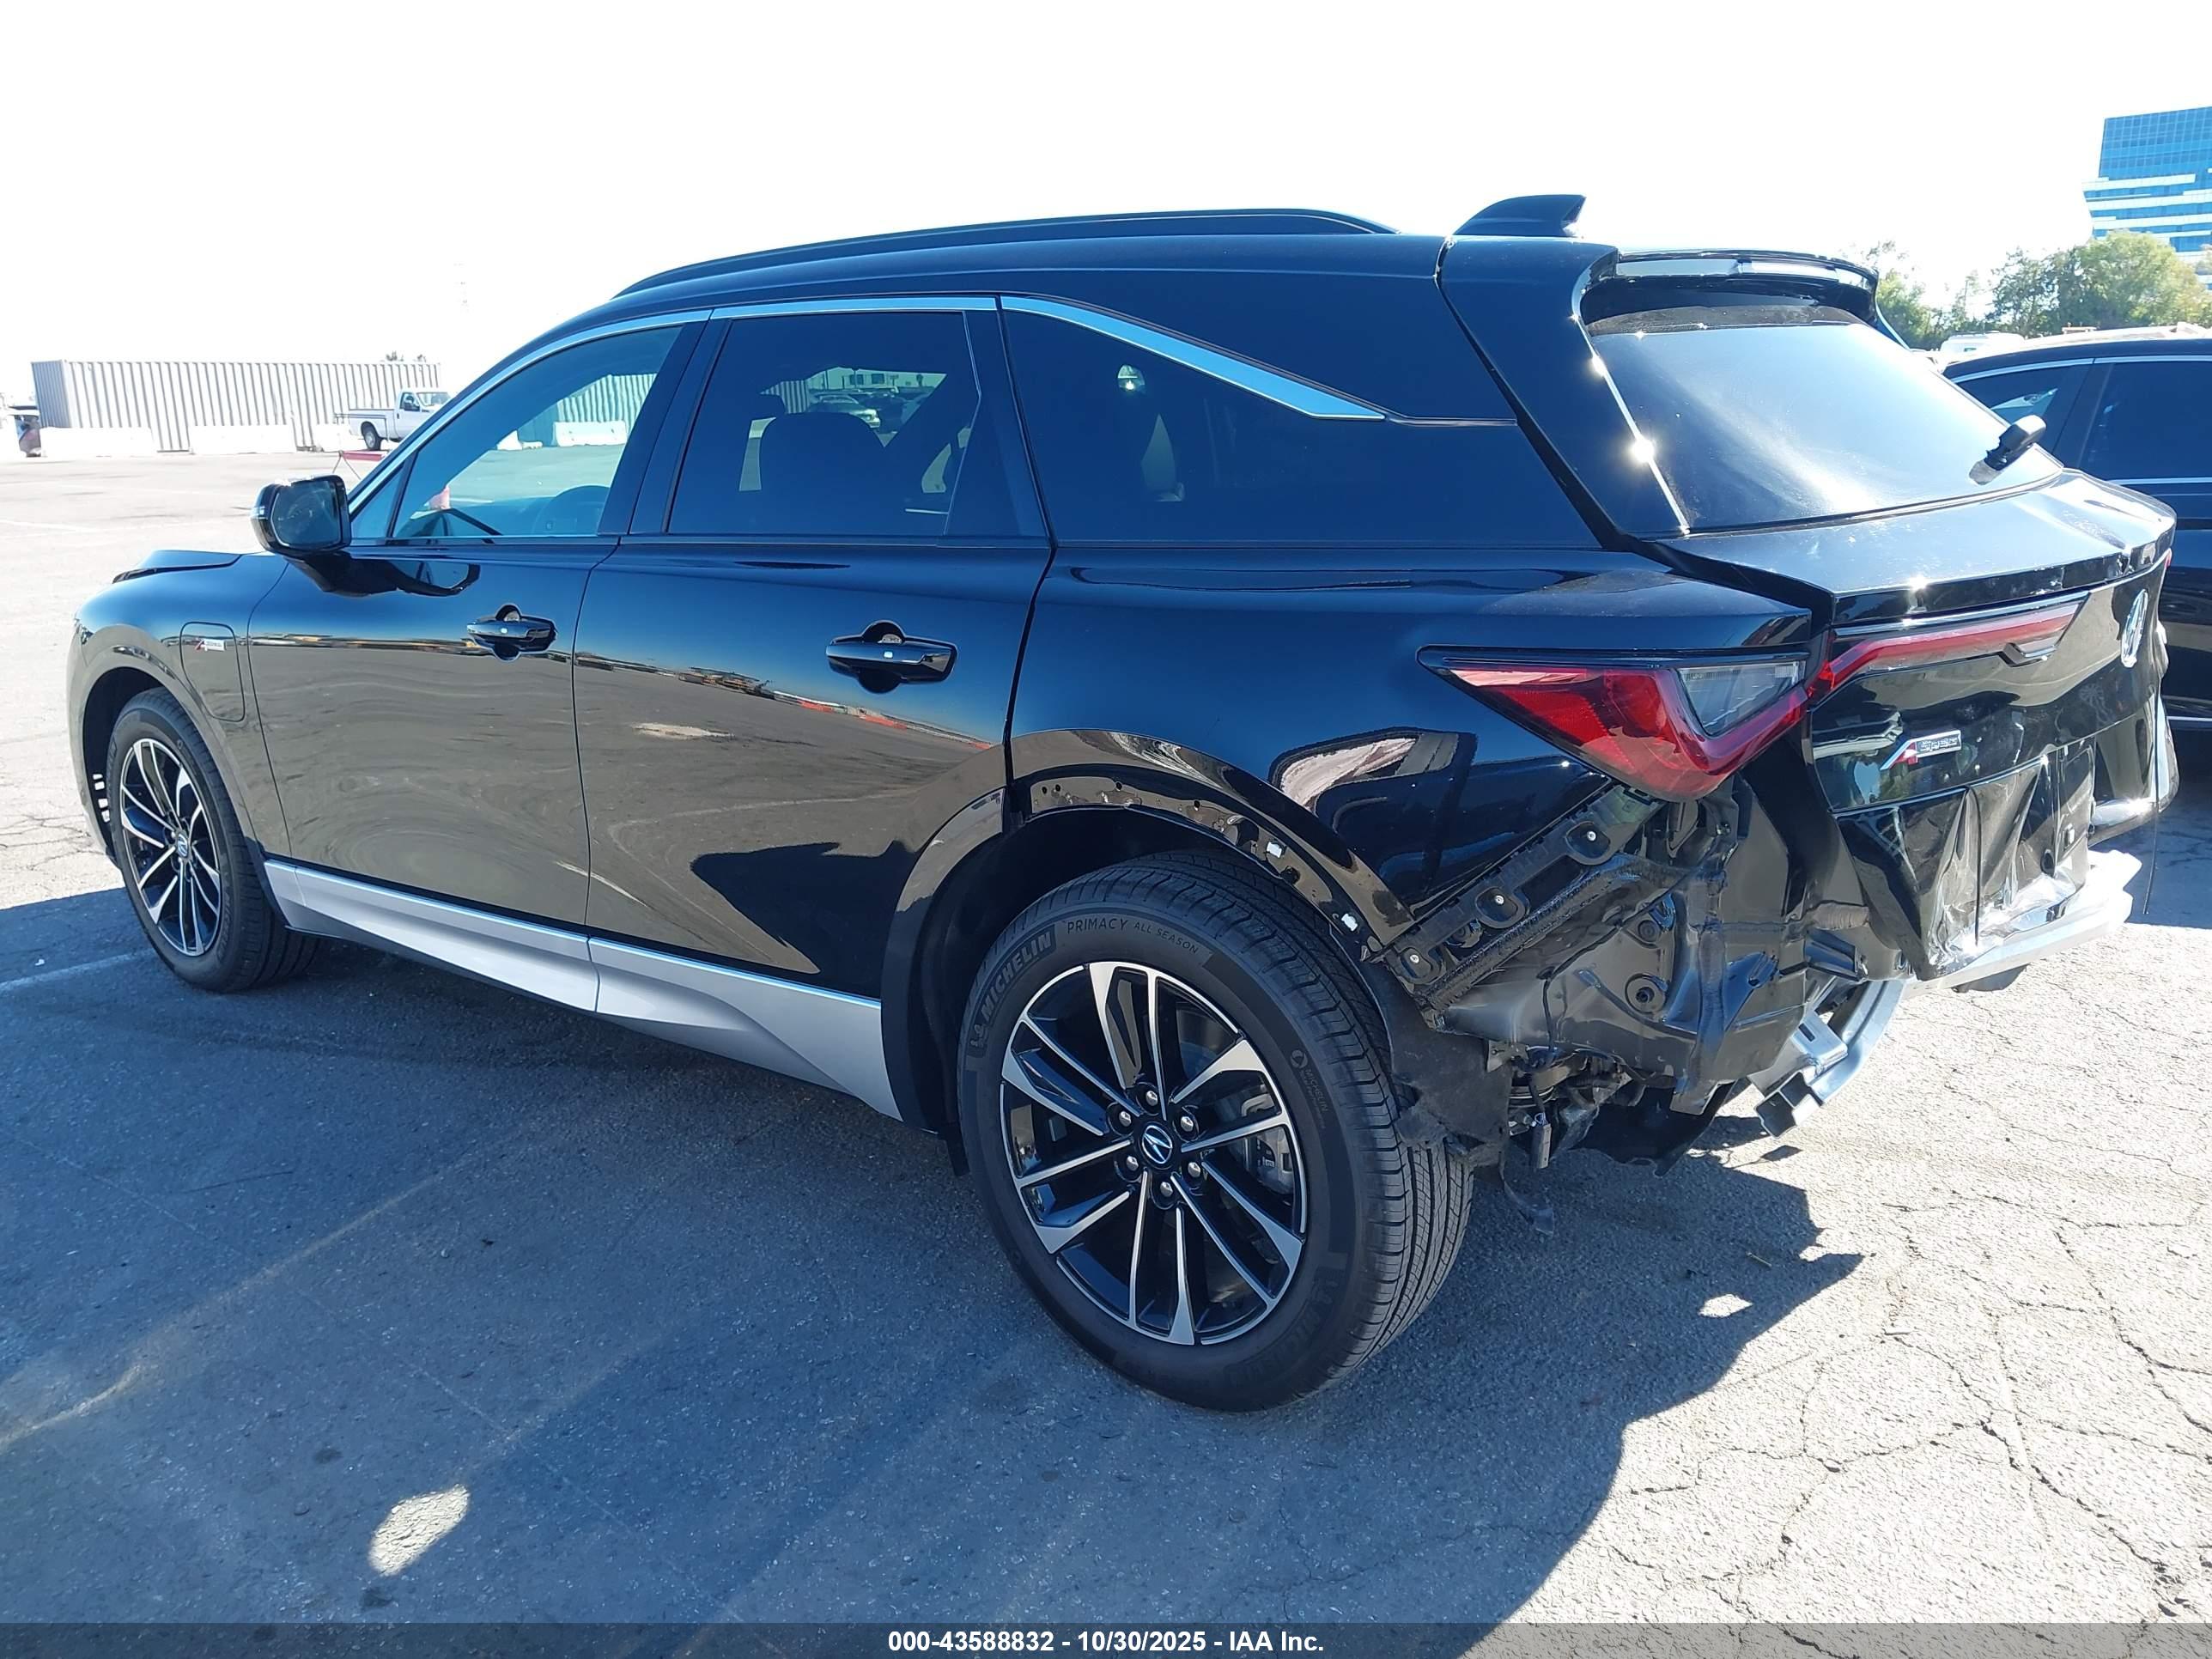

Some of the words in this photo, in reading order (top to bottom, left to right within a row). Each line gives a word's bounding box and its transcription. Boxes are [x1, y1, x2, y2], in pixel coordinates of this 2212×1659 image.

[1066, 917, 1128, 935] PRIMACY
[1133, 921, 1152, 935] ALL
[1156, 928, 1200, 954] SEASON
[981, 931, 1052, 1020] MICHELIN
